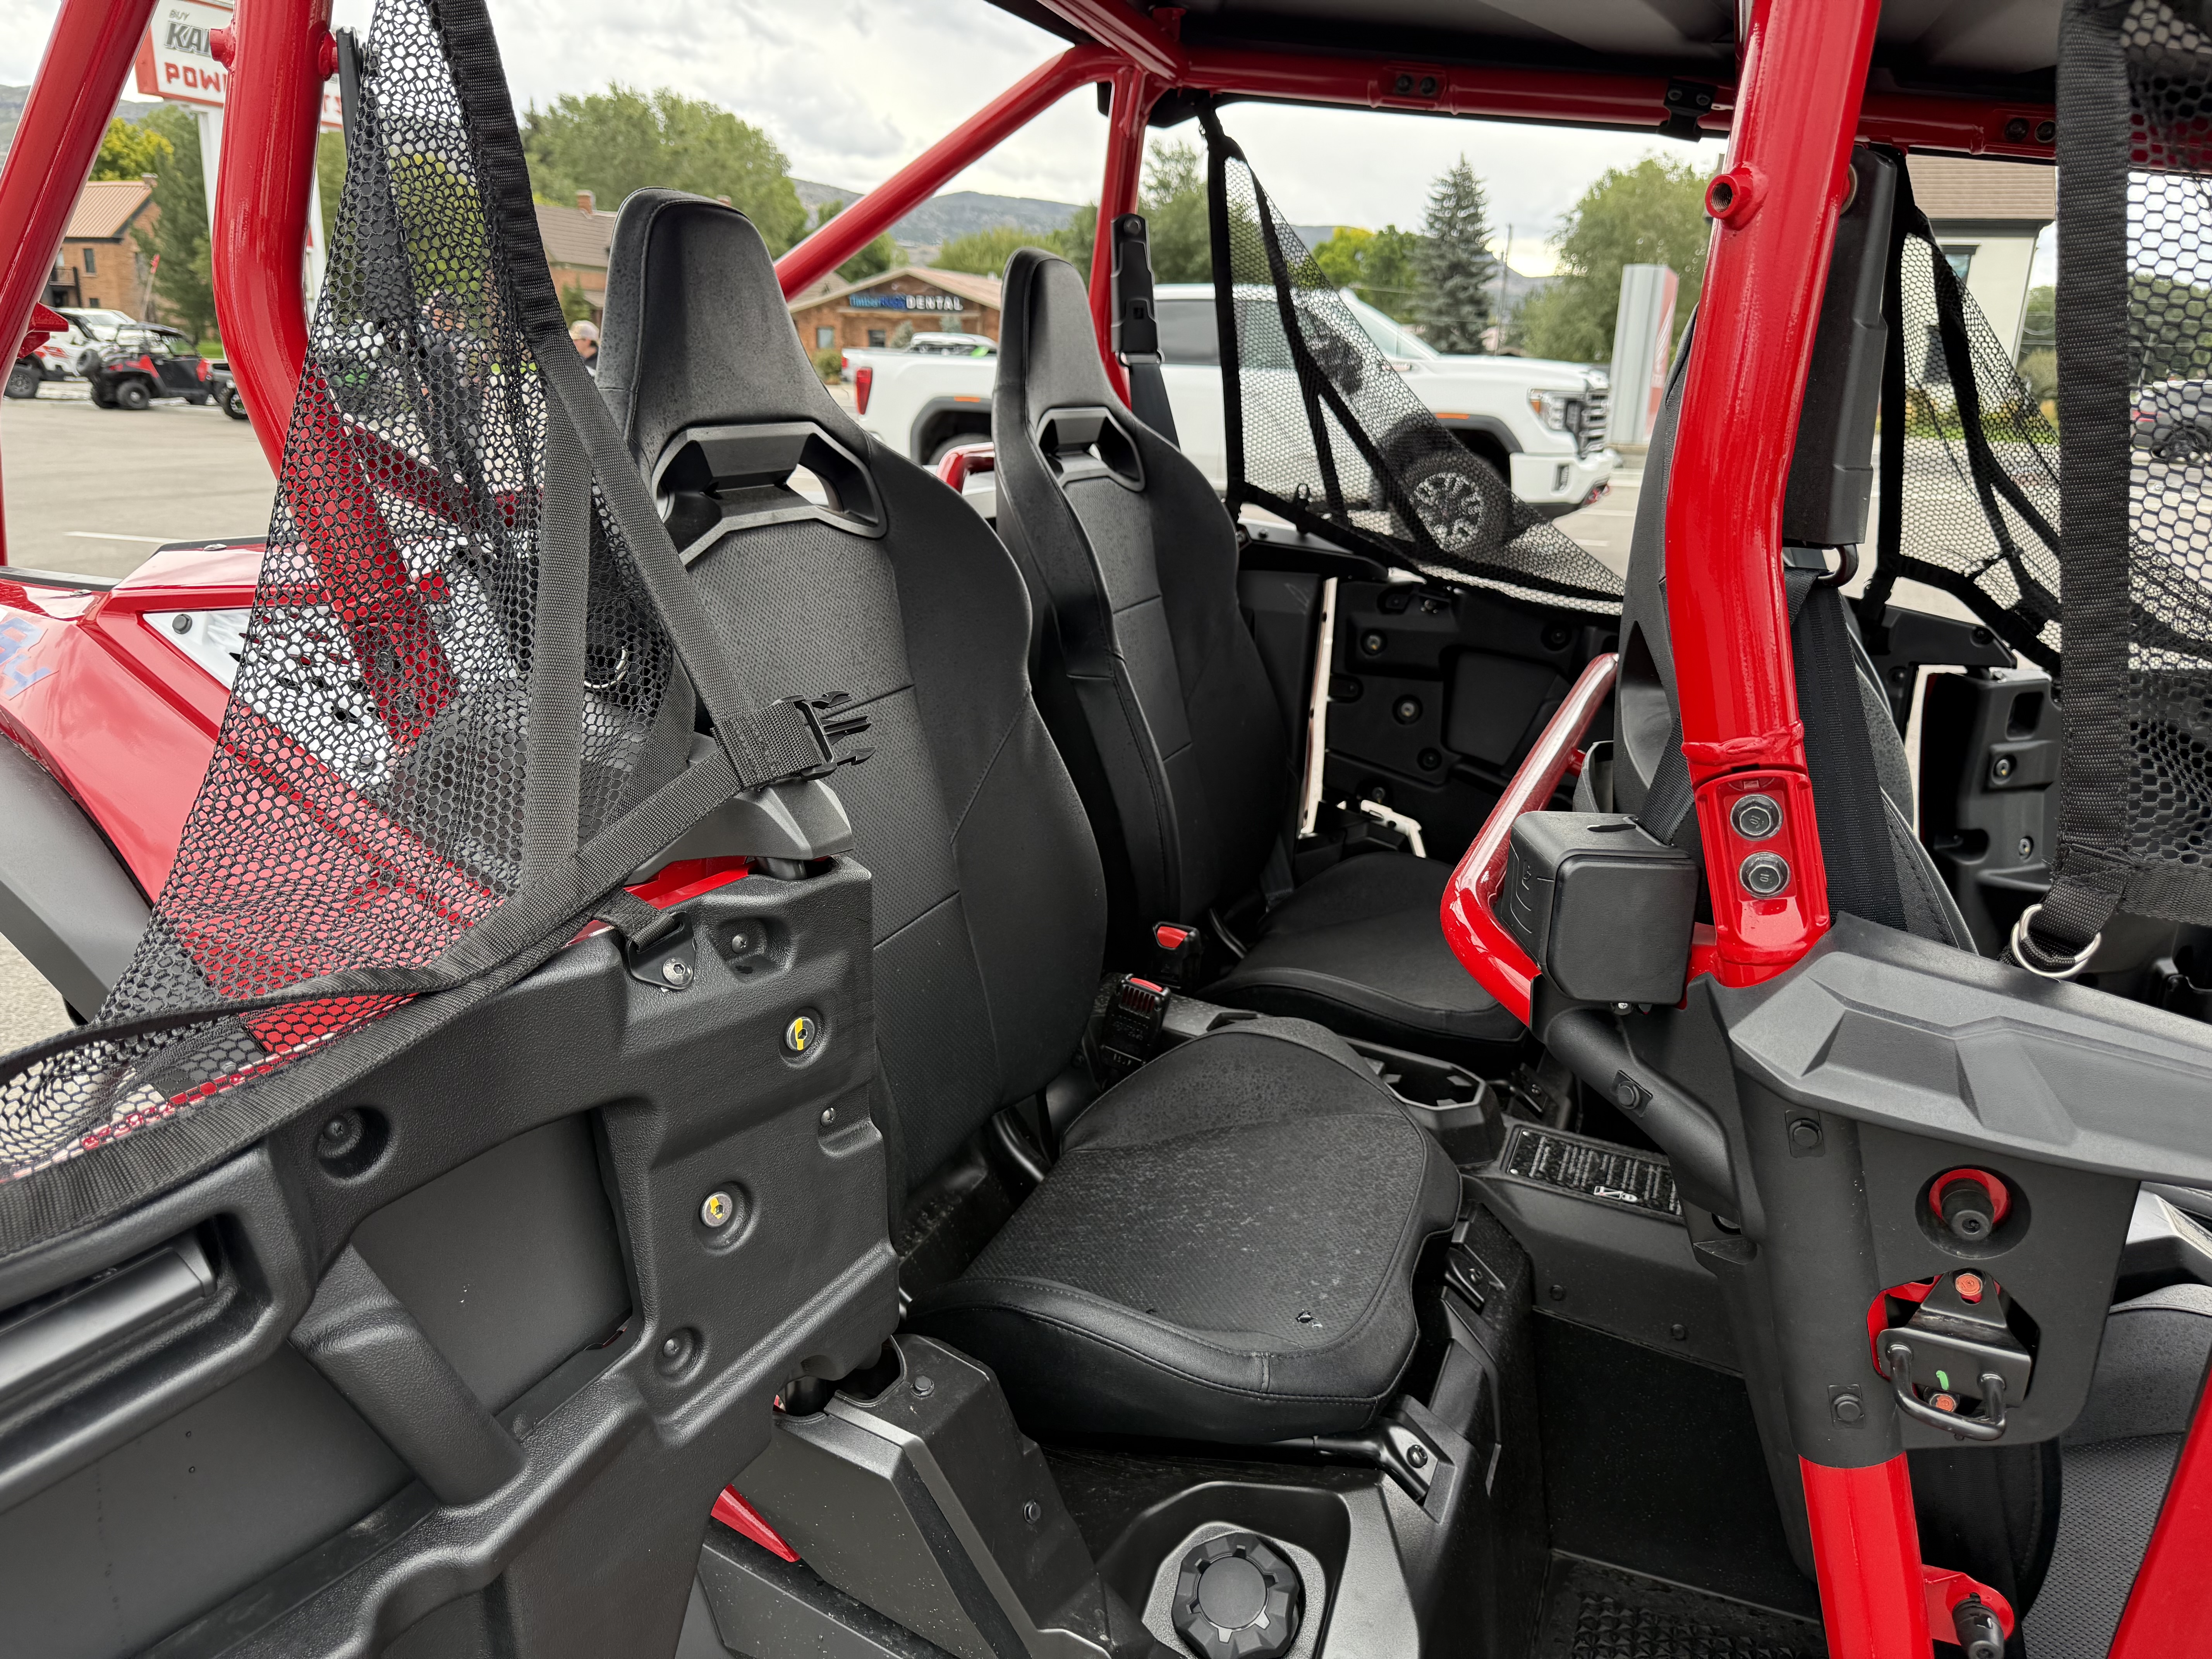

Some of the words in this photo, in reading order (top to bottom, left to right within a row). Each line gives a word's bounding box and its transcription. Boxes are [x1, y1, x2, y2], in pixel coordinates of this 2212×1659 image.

[168, 9, 190, 21] BUY
[164, 62, 227, 93] POW
[906, 294, 963, 311] DENTAL
